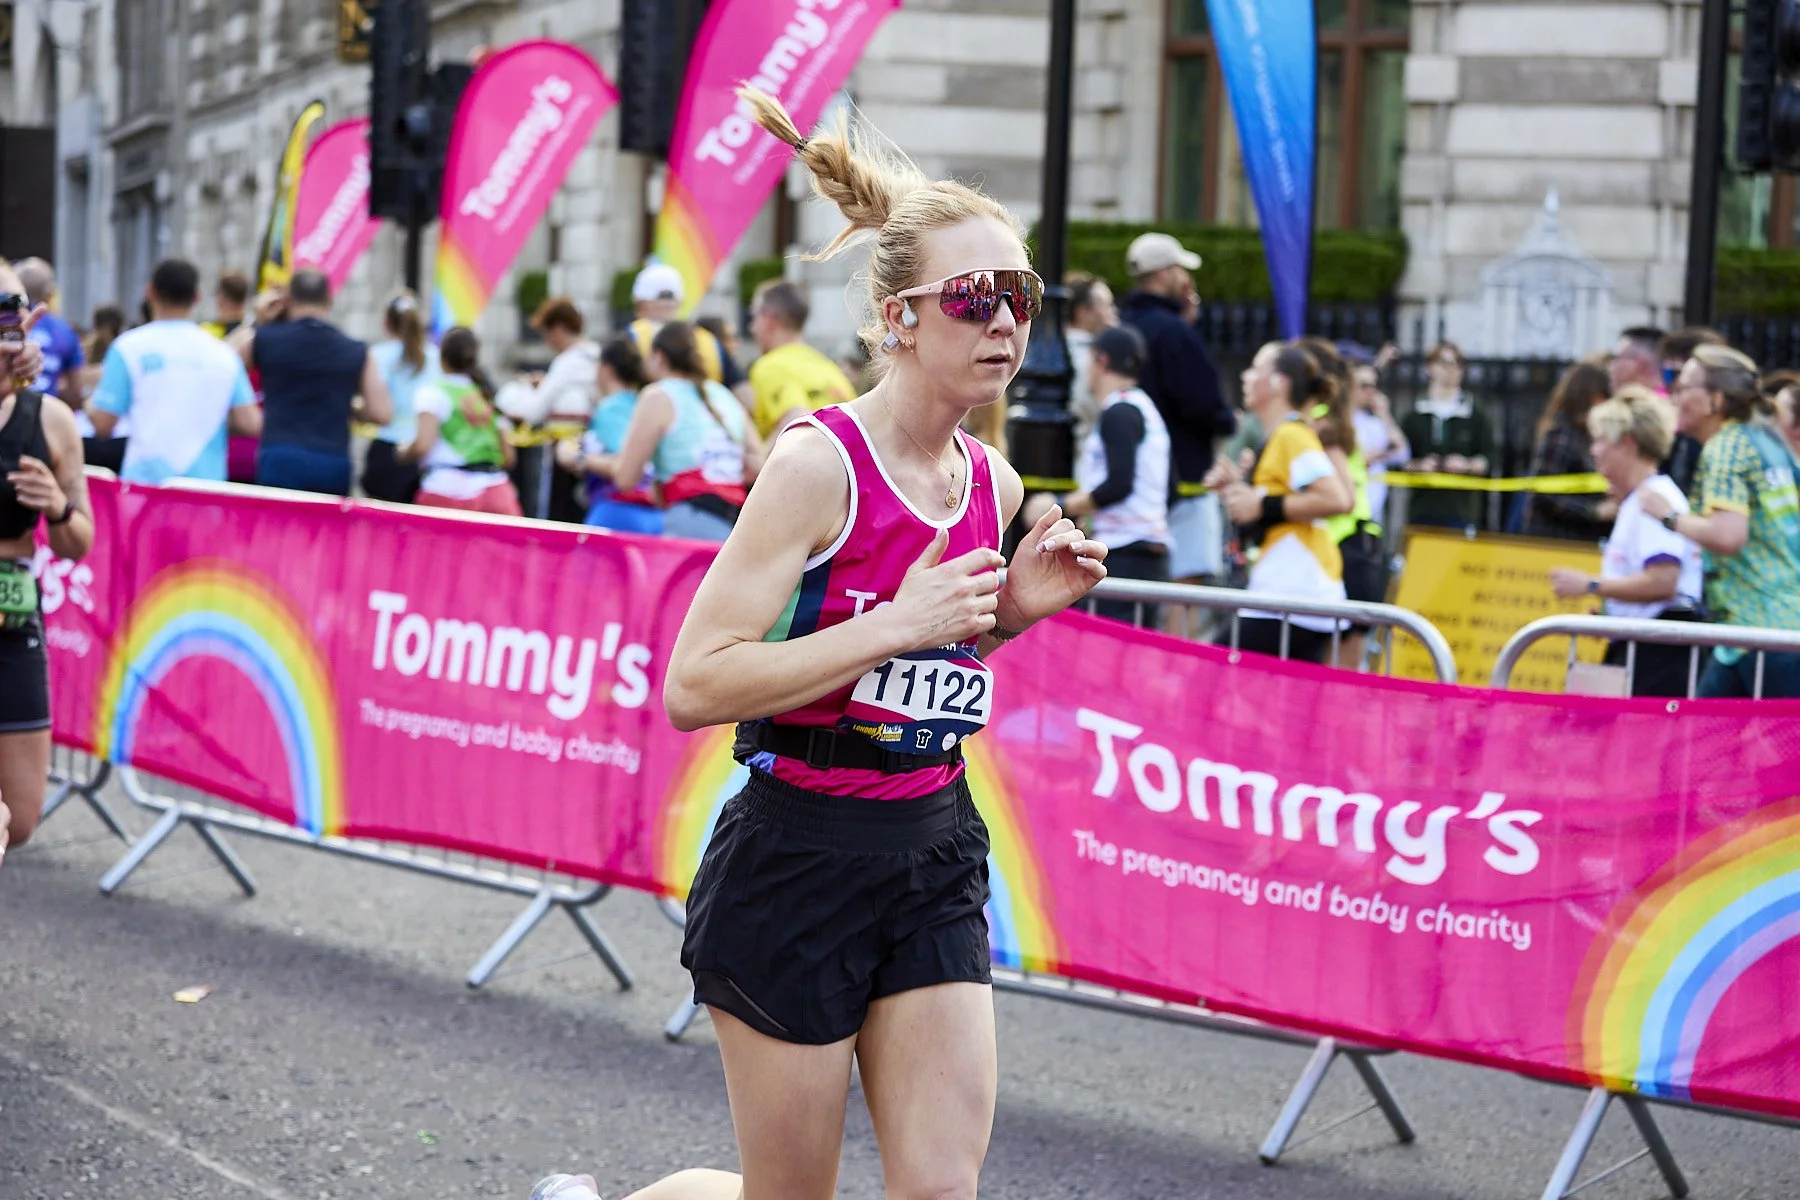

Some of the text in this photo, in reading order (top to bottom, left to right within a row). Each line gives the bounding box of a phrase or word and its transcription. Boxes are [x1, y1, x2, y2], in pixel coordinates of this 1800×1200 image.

[459, 75, 573, 220] Tommy's
[368, 589, 653, 721] Tommy's
[873, 660, 986, 717] 11122
[359, 698, 641, 775] The pregnancy and baby charity
[1076, 707, 1543, 886] Tommy's
[1072, 829, 1532, 951] The pregnancy and baby charity
